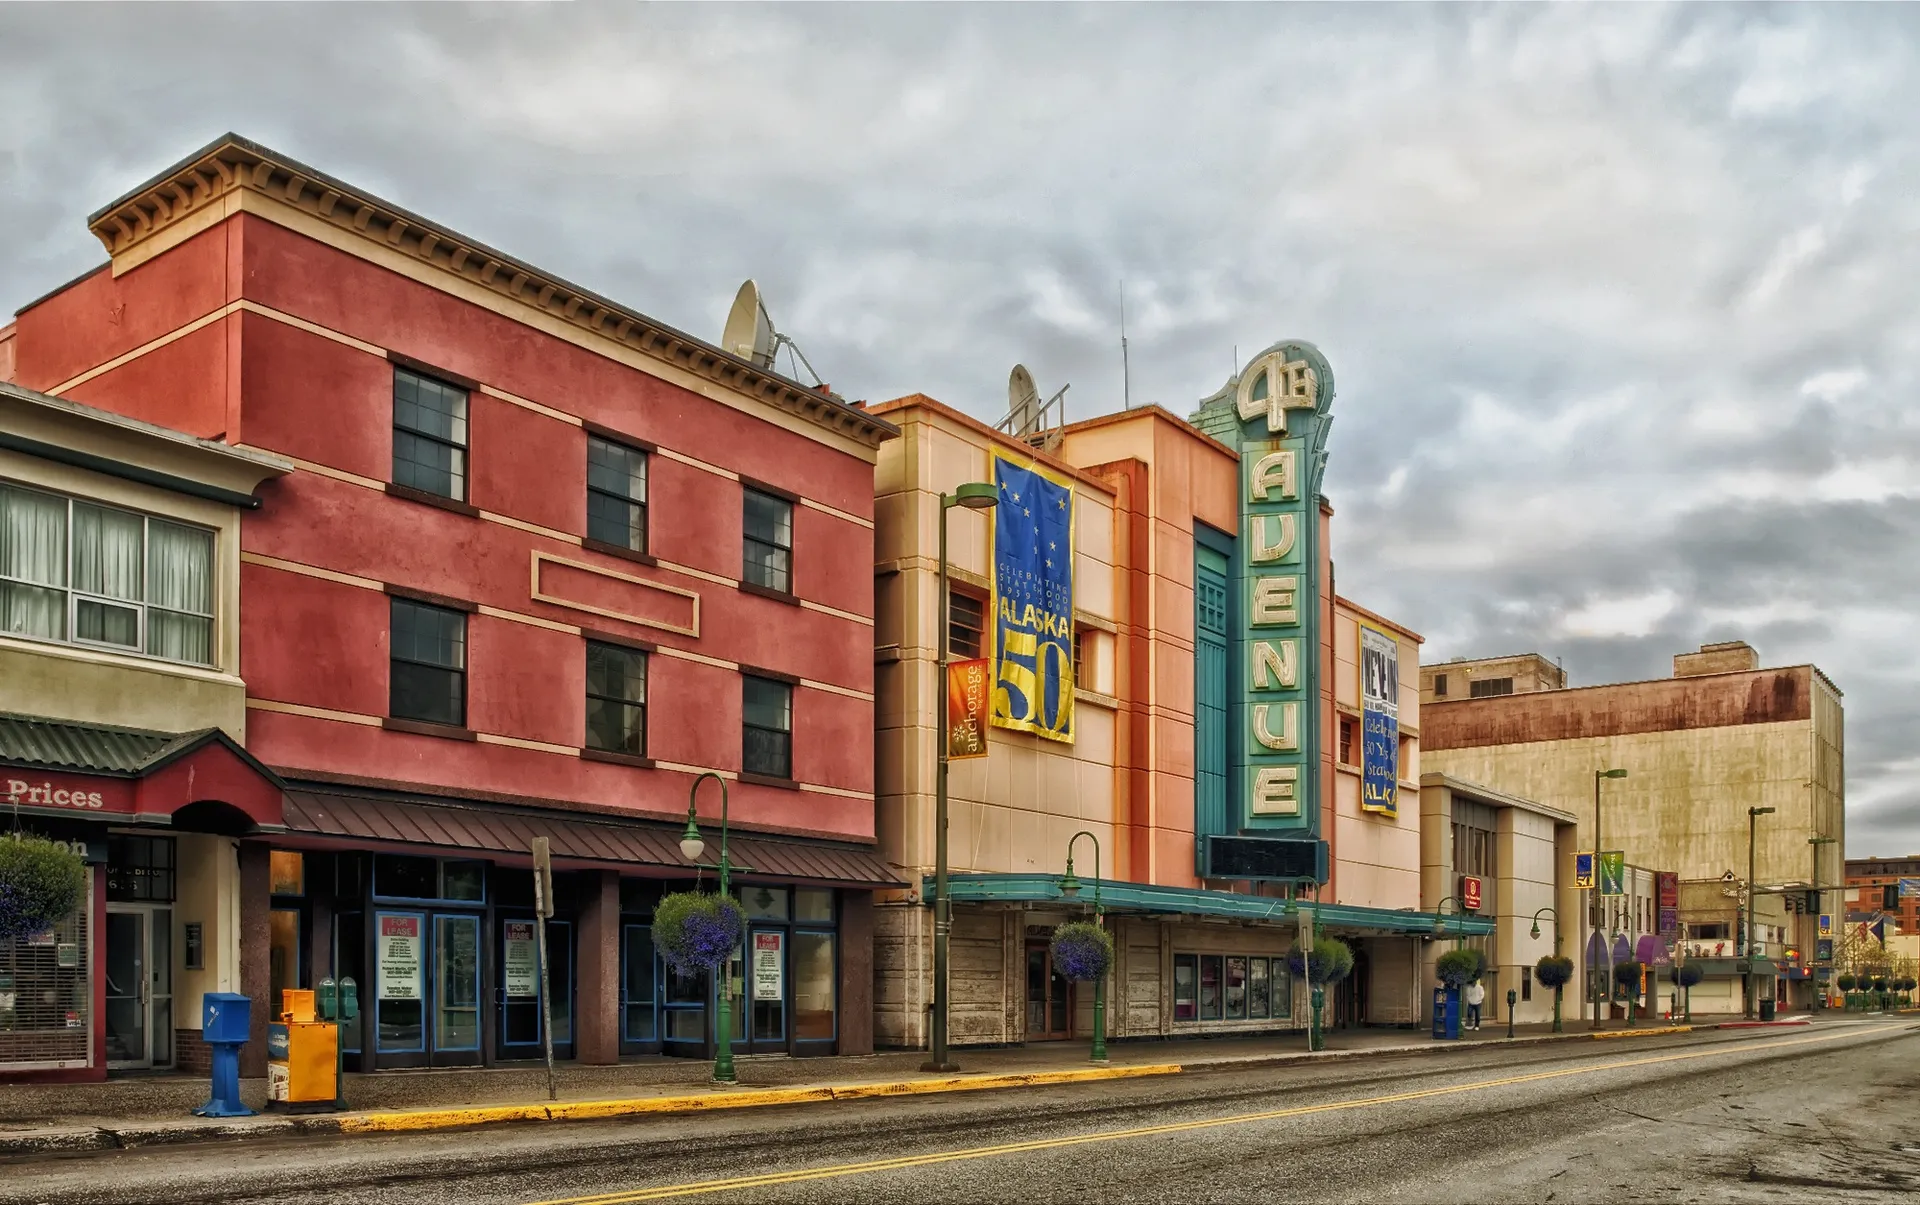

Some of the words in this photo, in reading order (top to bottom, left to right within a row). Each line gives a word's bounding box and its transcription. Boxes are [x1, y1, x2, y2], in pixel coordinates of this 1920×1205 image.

[1000, 596, 1070, 641] ALASKA
[1251, 449, 1299, 815] AVENUE
[996, 627, 1071, 732] 50
[963, 665, 982, 752] anchorage
[7, 779, 104, 809] Prices
[387, 927, 413, 936] LEASE
[391, 918, 408, 926] FOR
[507, 932, 530, 940] LEASE
[511, 924, 526, 932] FOR
